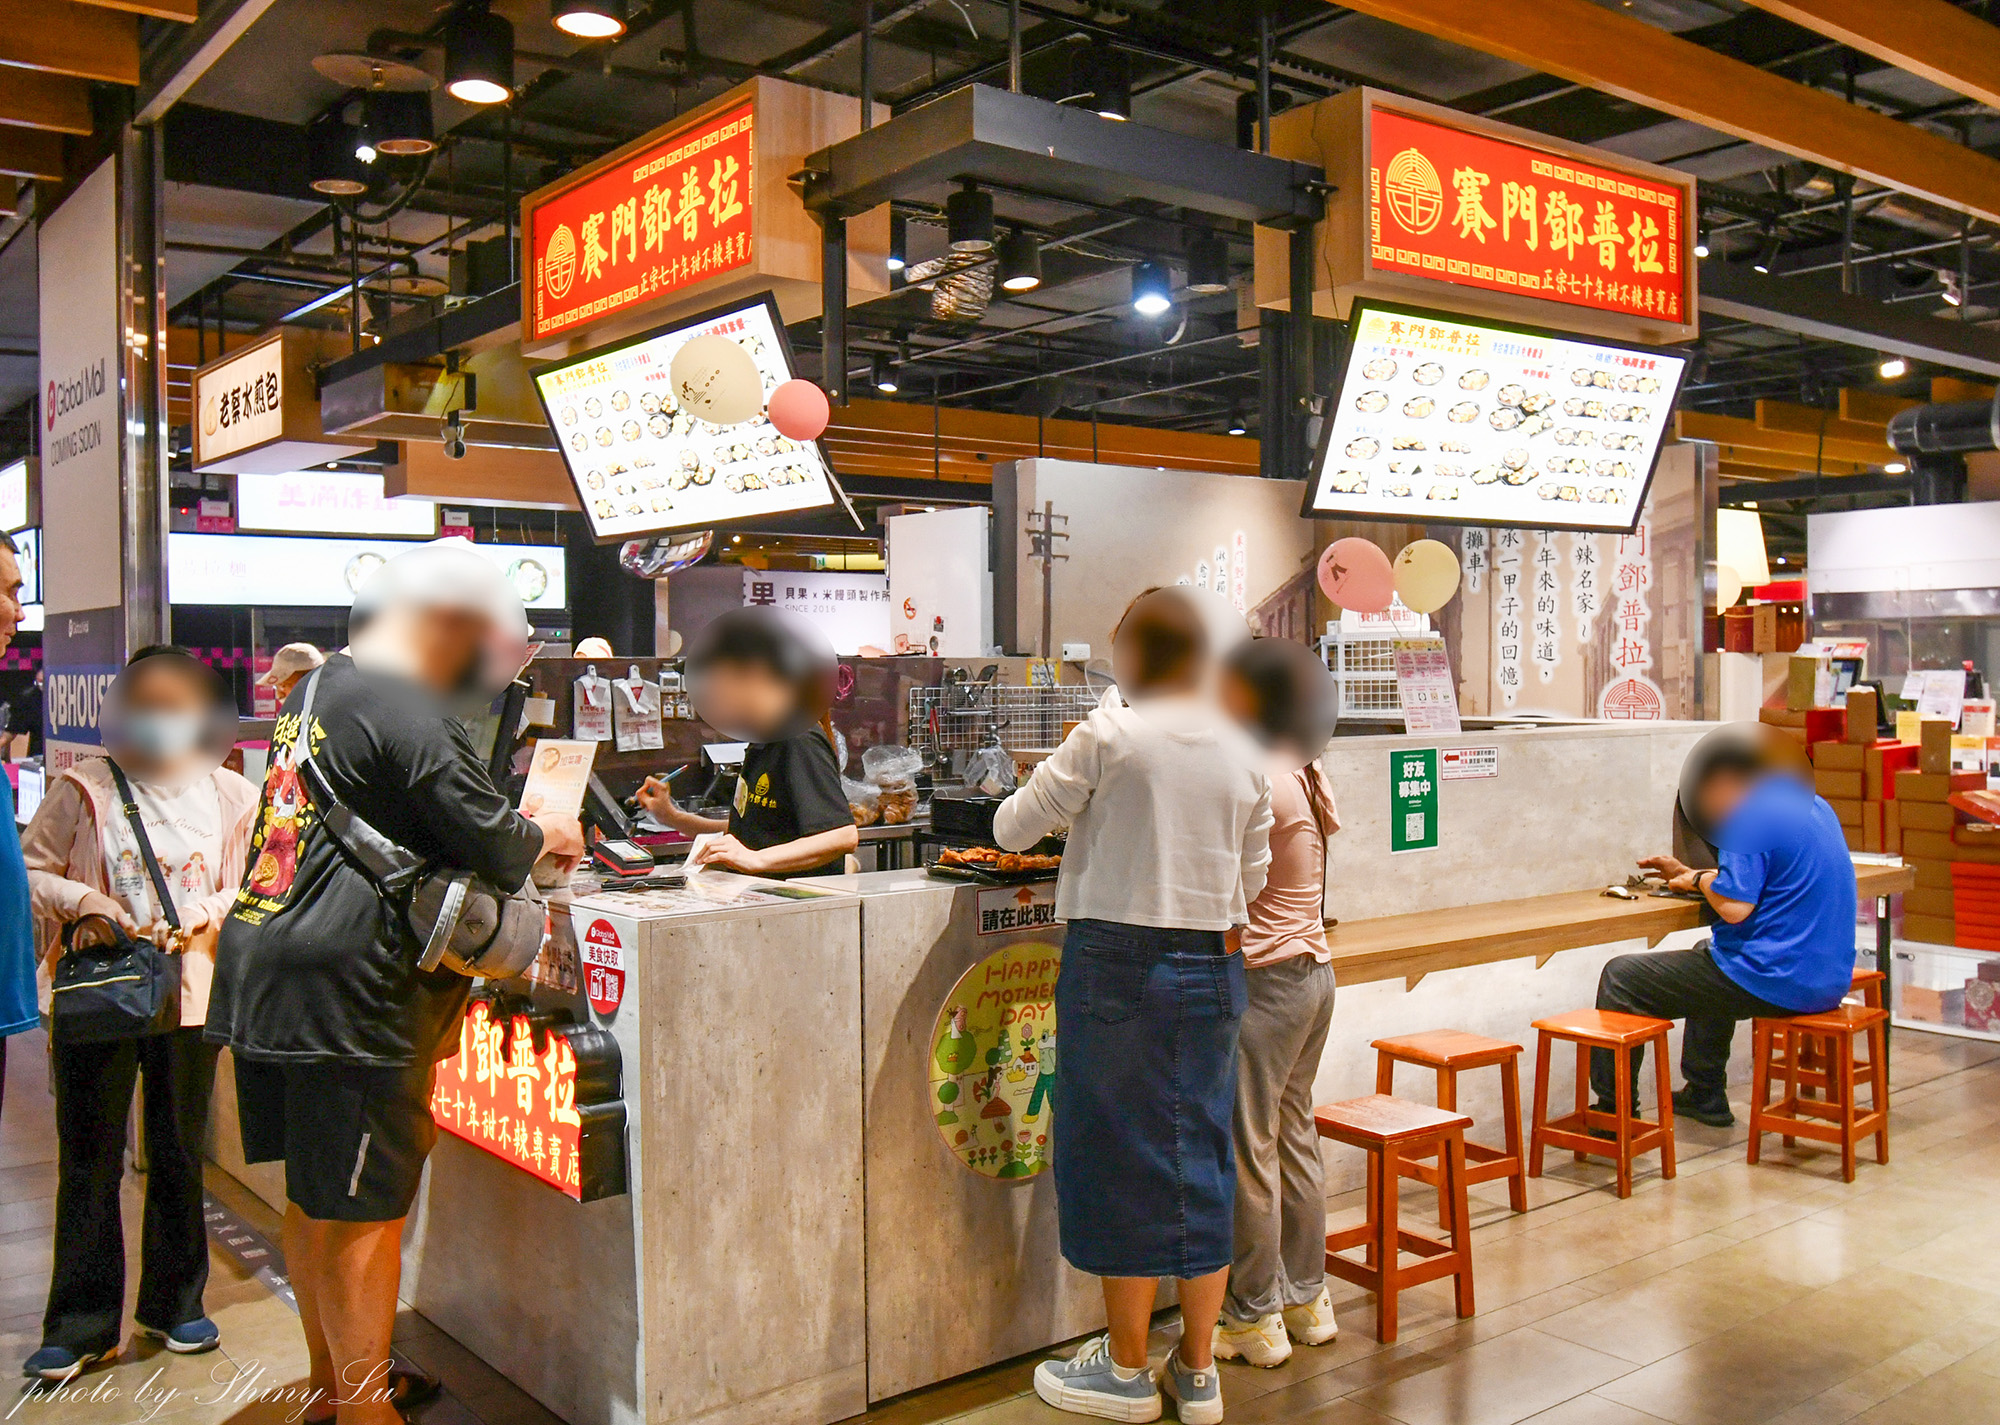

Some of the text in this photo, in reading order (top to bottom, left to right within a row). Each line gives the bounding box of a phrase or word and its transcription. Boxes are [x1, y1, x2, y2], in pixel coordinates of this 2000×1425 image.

[580, 154, 743, 285] 賽門鄧普拉
[1450, 165, 1666, 275] 賽門鄧普拉
[639, 231, 752, 297] 正宗七十年甜不辣專賣
[1541, 268, 1679, 316] 正宗七十年甜不辣專賣店
[56, 357, 106, 417] Global Mall
[218, 371, 280, 429] 老蔡水煎包
[50, 420, 102, 467] COMING SOON
[785, 604, 836, 614] SINCE 2016
[1615, 503, 1648, 668] 門鄧普拉
[1398, 779, 1431, 798] 募集中
[1402, 760, 1426, 779] 好友
[588, 945, 619, 967] 美食快取
[985, 958, 1061, 985] HAPPY
[999, 1002, 1052, 1026] DAY
